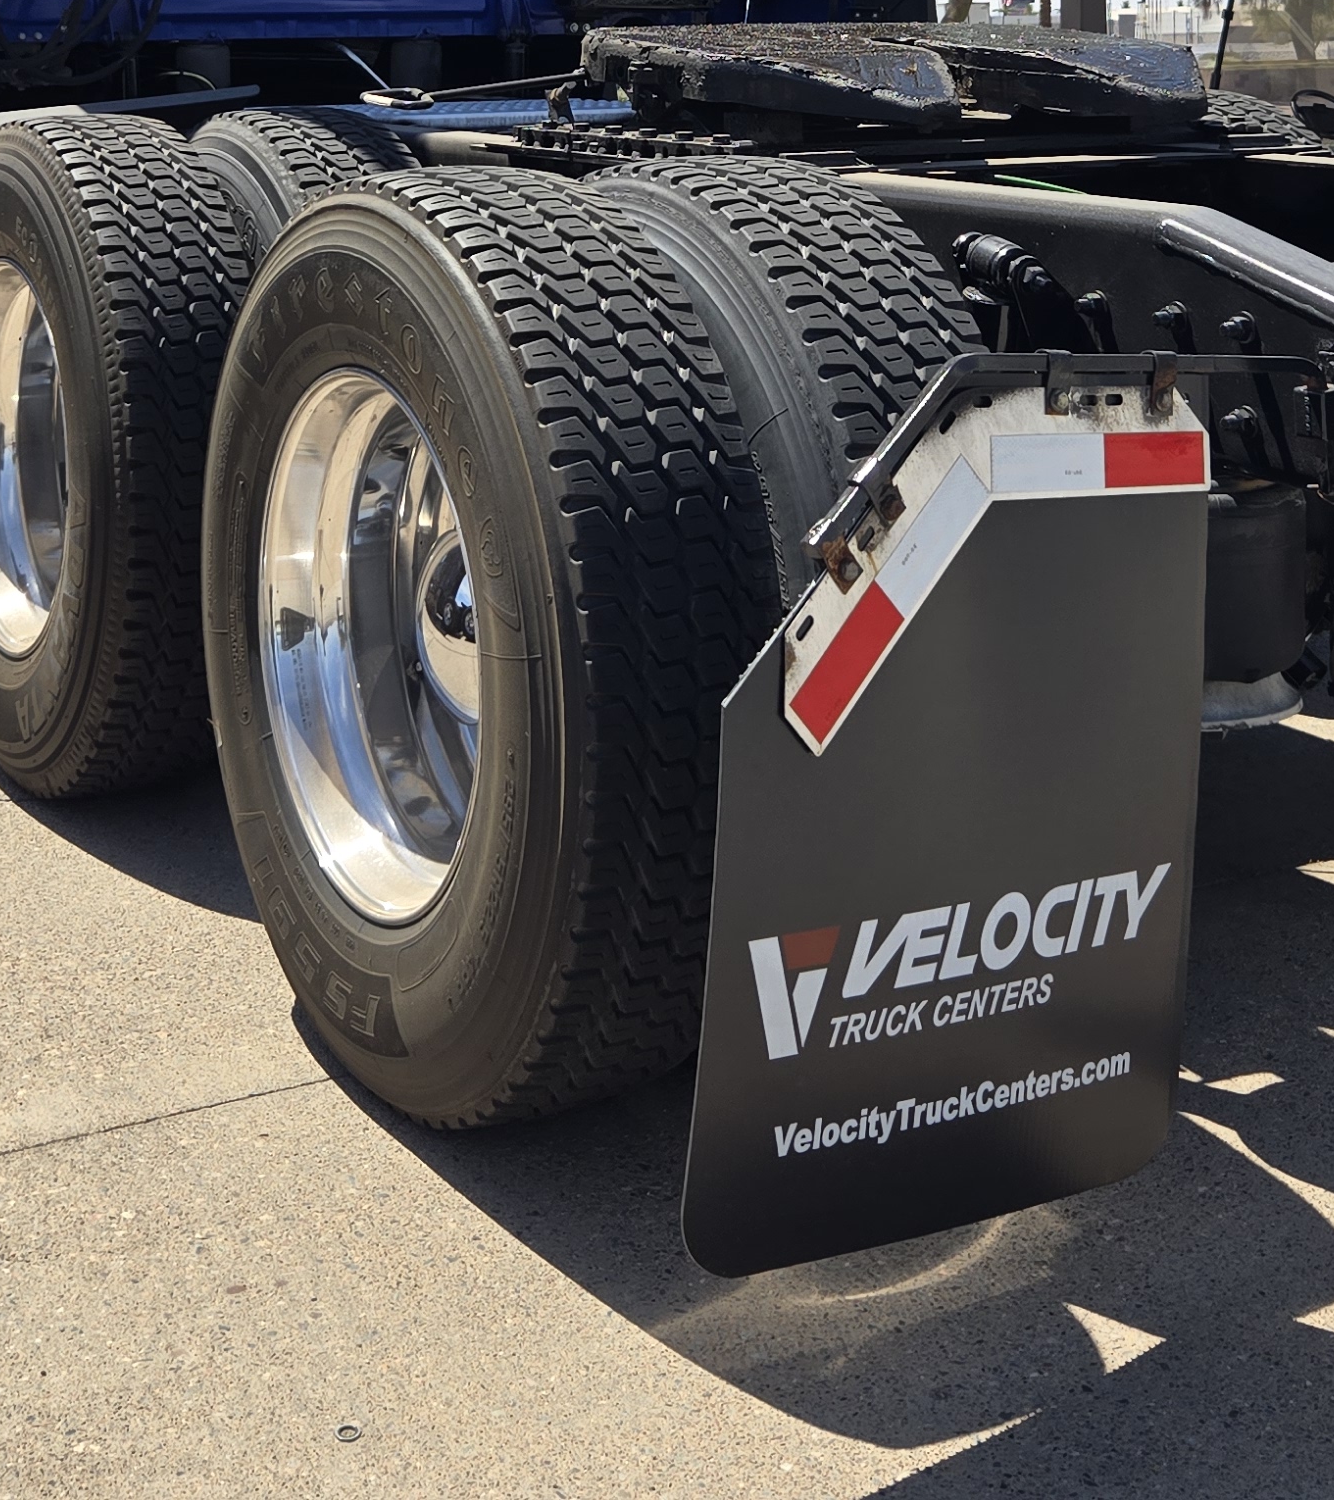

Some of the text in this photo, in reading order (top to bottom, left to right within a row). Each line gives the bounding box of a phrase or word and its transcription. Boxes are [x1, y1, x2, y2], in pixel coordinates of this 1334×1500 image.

[248, 267, 479, 497] Firestone
[841, 862, 1171, 999] VELOCITY
[828, 973, 1054, 1048] TRUCK CENTERS
[774, 1051, 1130, 1158] VelocityTruckCenters.com
